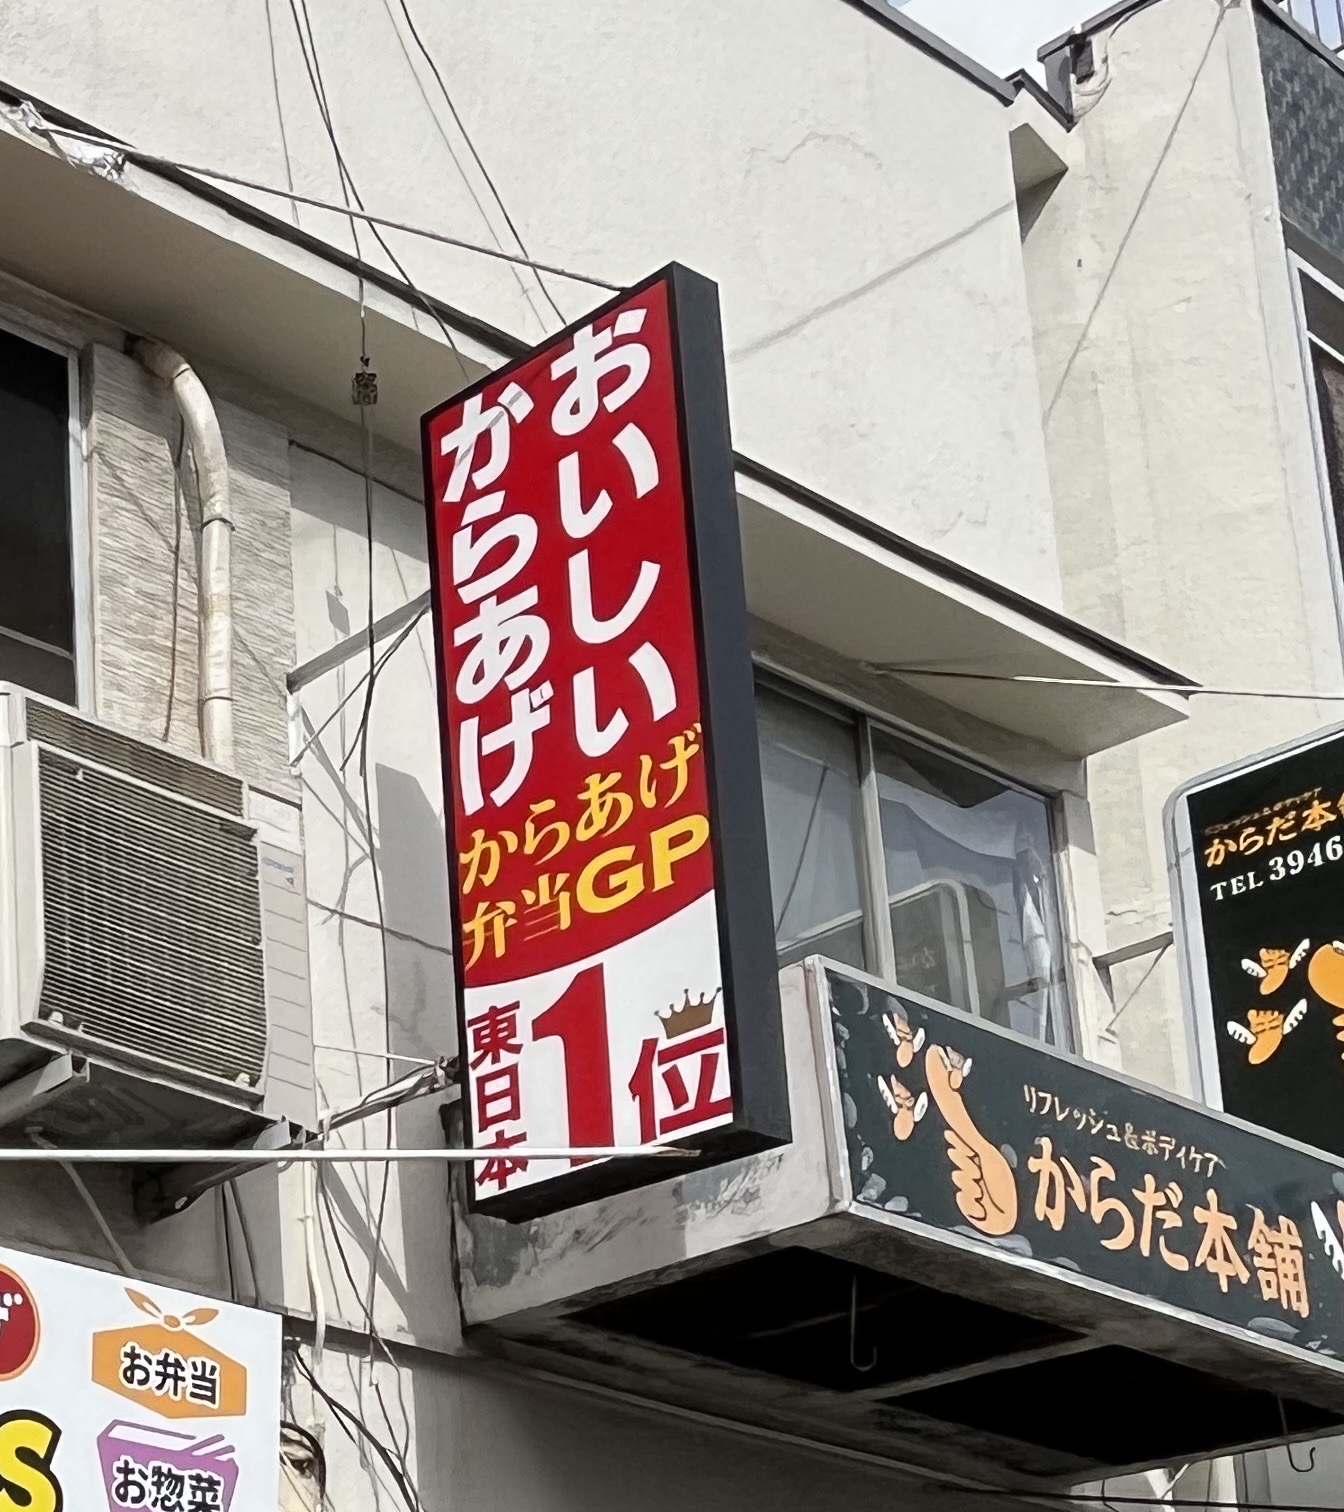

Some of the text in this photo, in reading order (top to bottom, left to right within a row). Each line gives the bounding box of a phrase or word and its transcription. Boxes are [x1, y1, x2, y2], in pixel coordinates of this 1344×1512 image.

[440, 378, 551, 818] からあげ
[550, 307, 678, 759] おいしい
[458, 722, 703, 896] からあげ
[461, 815, 711, 971] 弁当GP
[1203, 792, 1344, 868] からだ本
[1210, 834, 1344, 901] TEL 3946
[466, 1002, 524, 1190] 東日本
[1027, 1136, 1309, 1319] からだ本舗
[119, 1346, 220, 1407] お弁当
